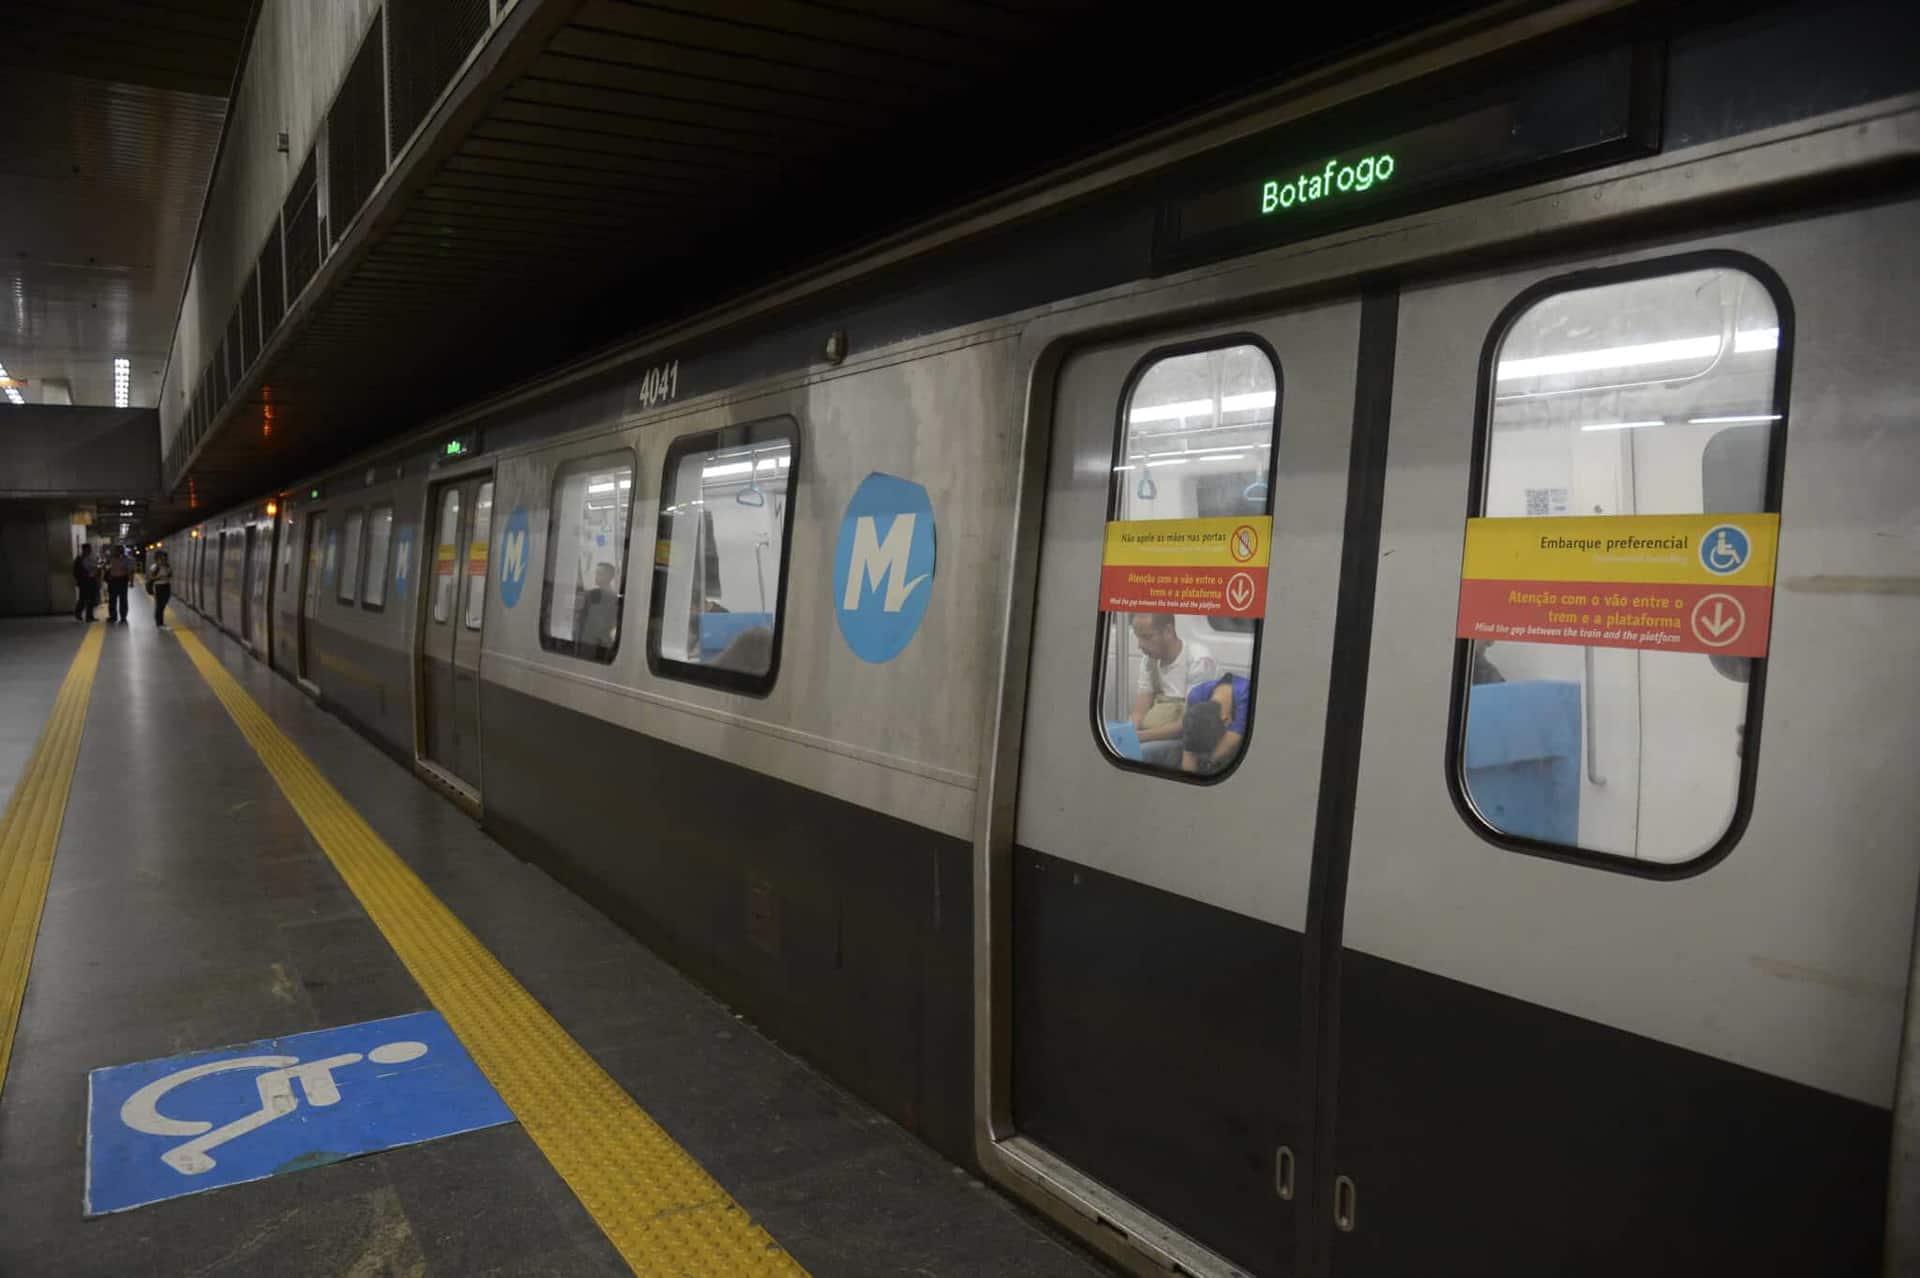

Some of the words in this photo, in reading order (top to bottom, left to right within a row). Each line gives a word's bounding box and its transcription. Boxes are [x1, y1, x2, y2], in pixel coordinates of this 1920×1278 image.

[1261, 154, 1395, 214] Botafogo
[640, 360, 679, 408] 4041
[1188, 533, 1200, 542] nas
[1202, 531, 1227, 544] portas
[1540, 536, 1602, 552] Embarque
[1606, 535, 1689, 552] preferencial
[843, 513, 930, 612] M
[1128, 573, 1156, 586] Atenção
[1157, 575, 1172, 585] com
[1195, 575, 1216, 585] entre
[1217, 576, 1223, 585] o
[1151, 587, 1166, 597] trem
[1181, 587, 1222, 600] plataforma
[1508, 590, 1557, 607] Atenção
[1561, 595, 1587, 606] com
[1591, 596, 1600, 606] o
[1605, 593, 1628, 607] vão
[1632, 596, 1669, 608] entre
[1675, 599, 1684, 609] o
[1549, 610, 1577, 623] trem
[1582, 613, 1589, 623] e
[1594, 614, 1601, 623] a
[1606, 611, 1681, 629] plataforma
[1475, 622, 1495, 632] Mind
[1496, 624, 1509, 633] the
[1510, 626, 1525, 636] gap
[1527, 625, 1561, 636] between
[1563, 627, 1578, 637] the
[1580, 628, 1601, 638] train
[1603, 629, 1620, 639] and
[1623, 630, 1638, 640] the
[1639, 631, 1681, 644] platform
